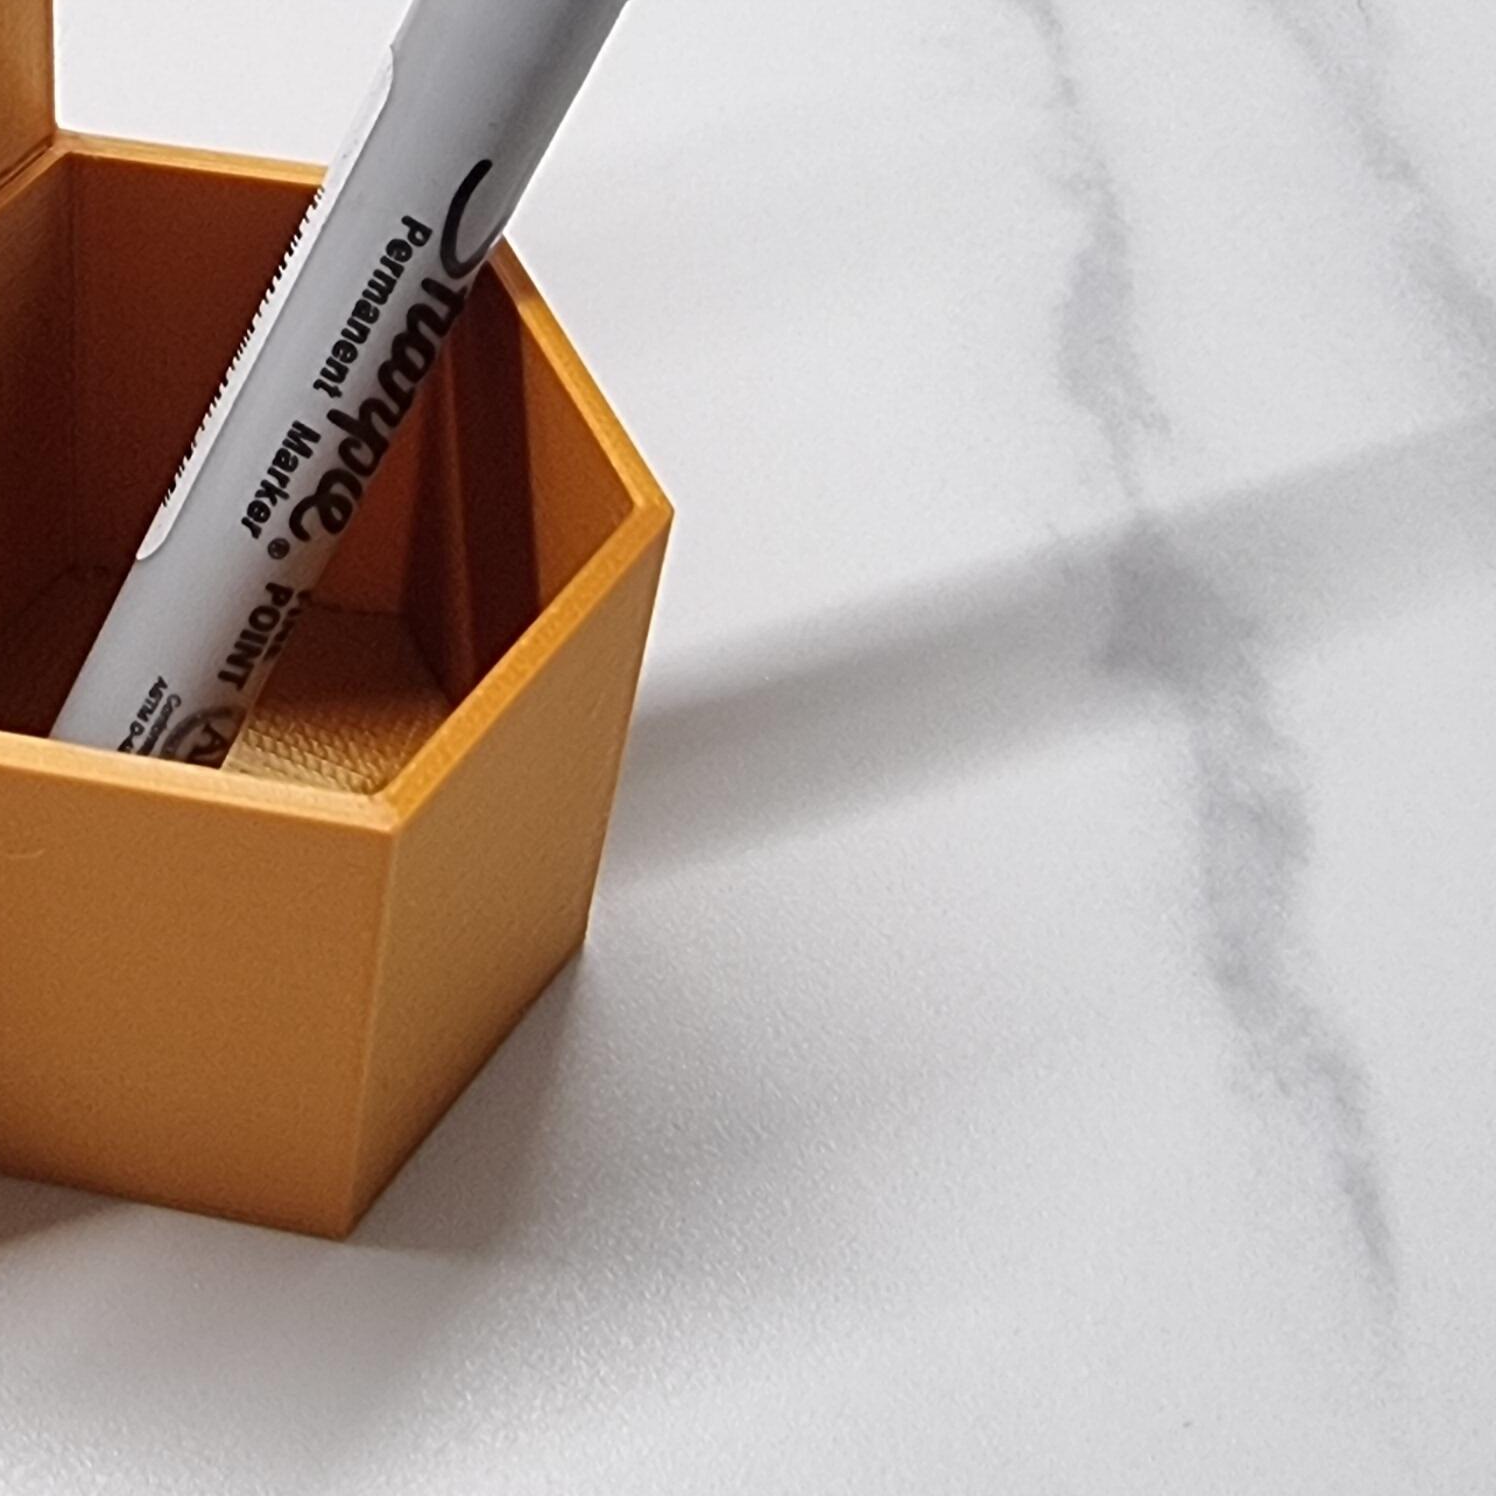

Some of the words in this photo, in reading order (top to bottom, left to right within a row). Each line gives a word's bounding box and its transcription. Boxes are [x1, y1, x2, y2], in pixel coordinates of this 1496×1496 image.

[312, 214, 434, 399] Permanent
[240, 419, 323, 540] Marker
[217, 582, 295, 691] POINT
[136, 675, 169, 723] ASTM
